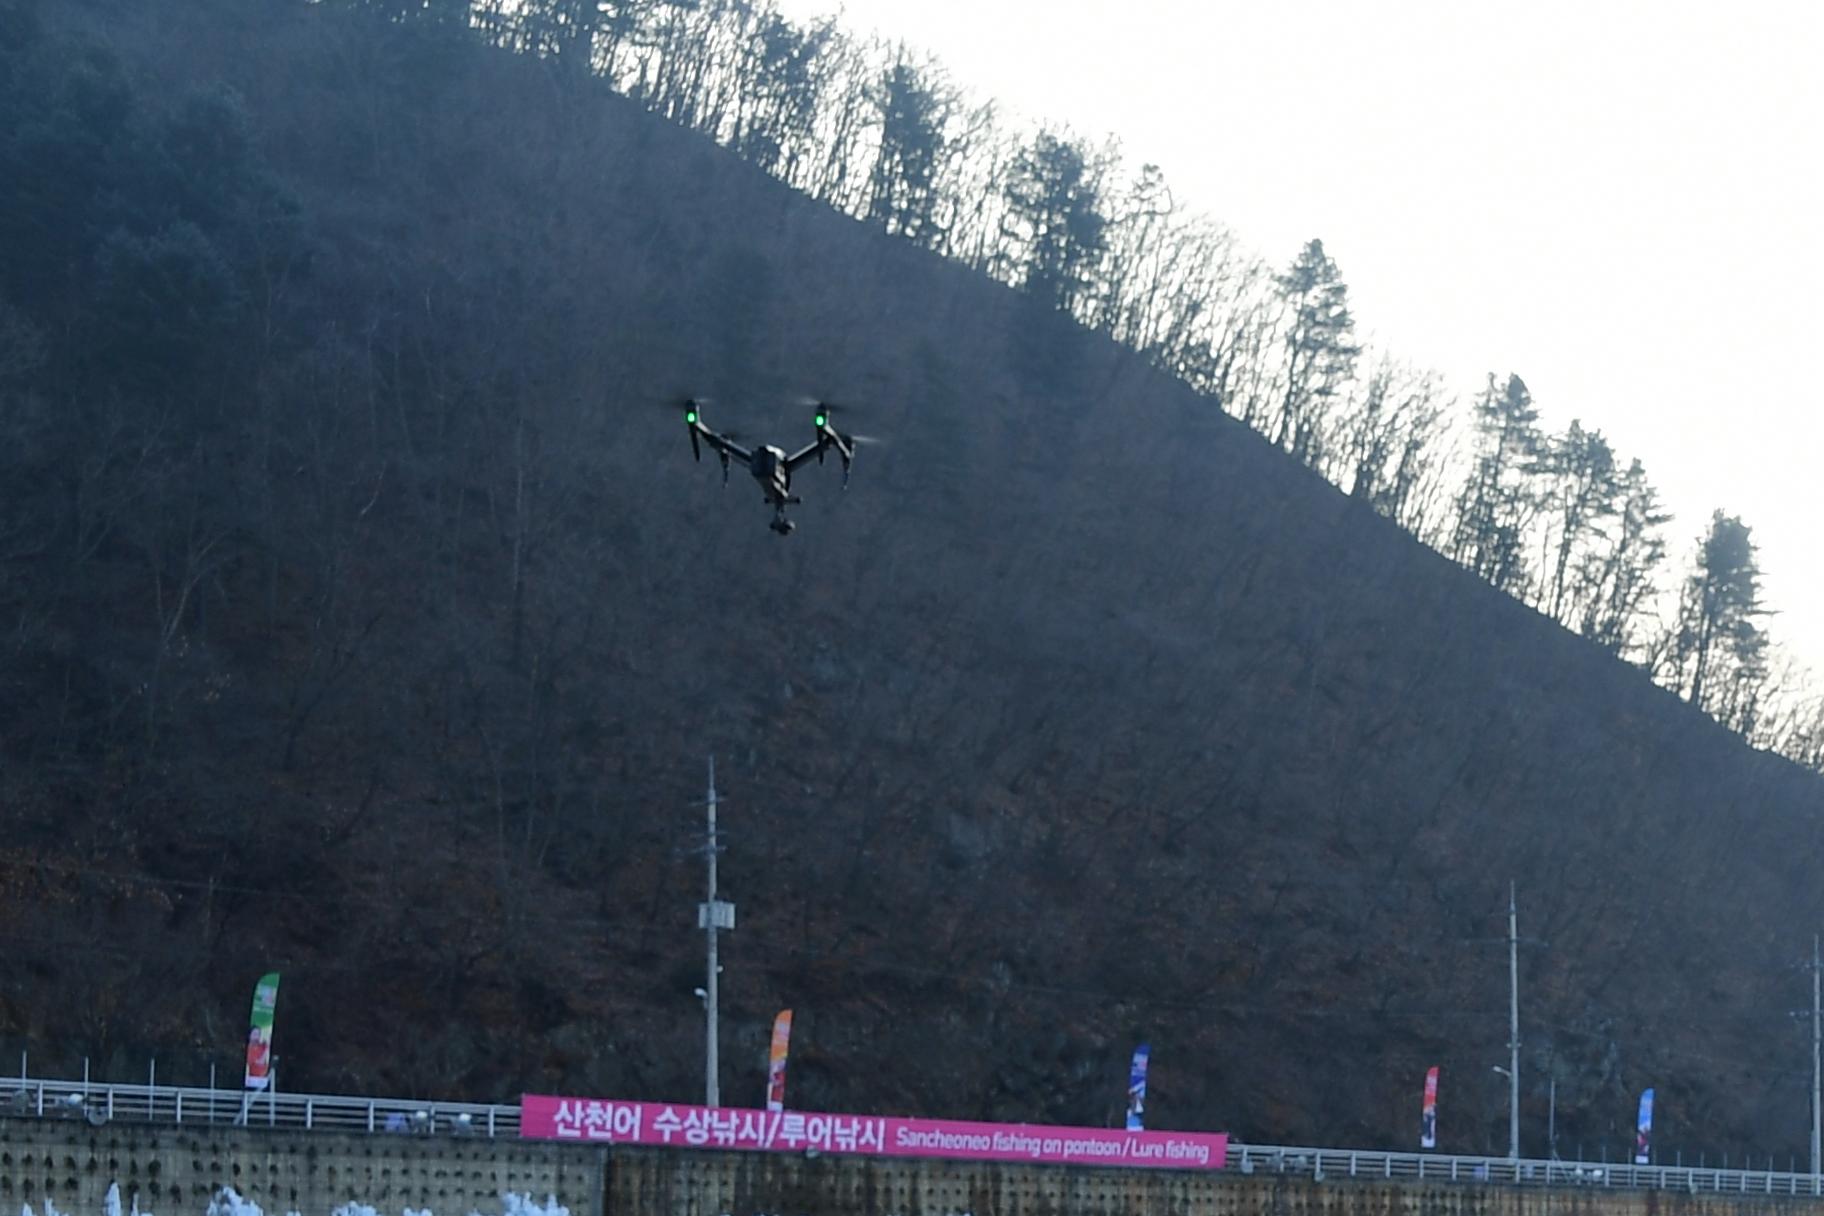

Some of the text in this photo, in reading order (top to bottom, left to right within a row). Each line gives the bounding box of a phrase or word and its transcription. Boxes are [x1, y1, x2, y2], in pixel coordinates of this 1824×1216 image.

[554, 1100, 885, 1153] 산천어 수상낚시/루어낚시
[896, 1126, 990, 1150] Sancheoneo
[993, 1131, 1041, 1158] fishing
[1042, 1138, 1062, 1154] on
[1063, 1138, 1121, 1158] pontoon
[1131, 1140, 1164, 1158] Lure
[1165, 1141, 1209, 1165] fishing
